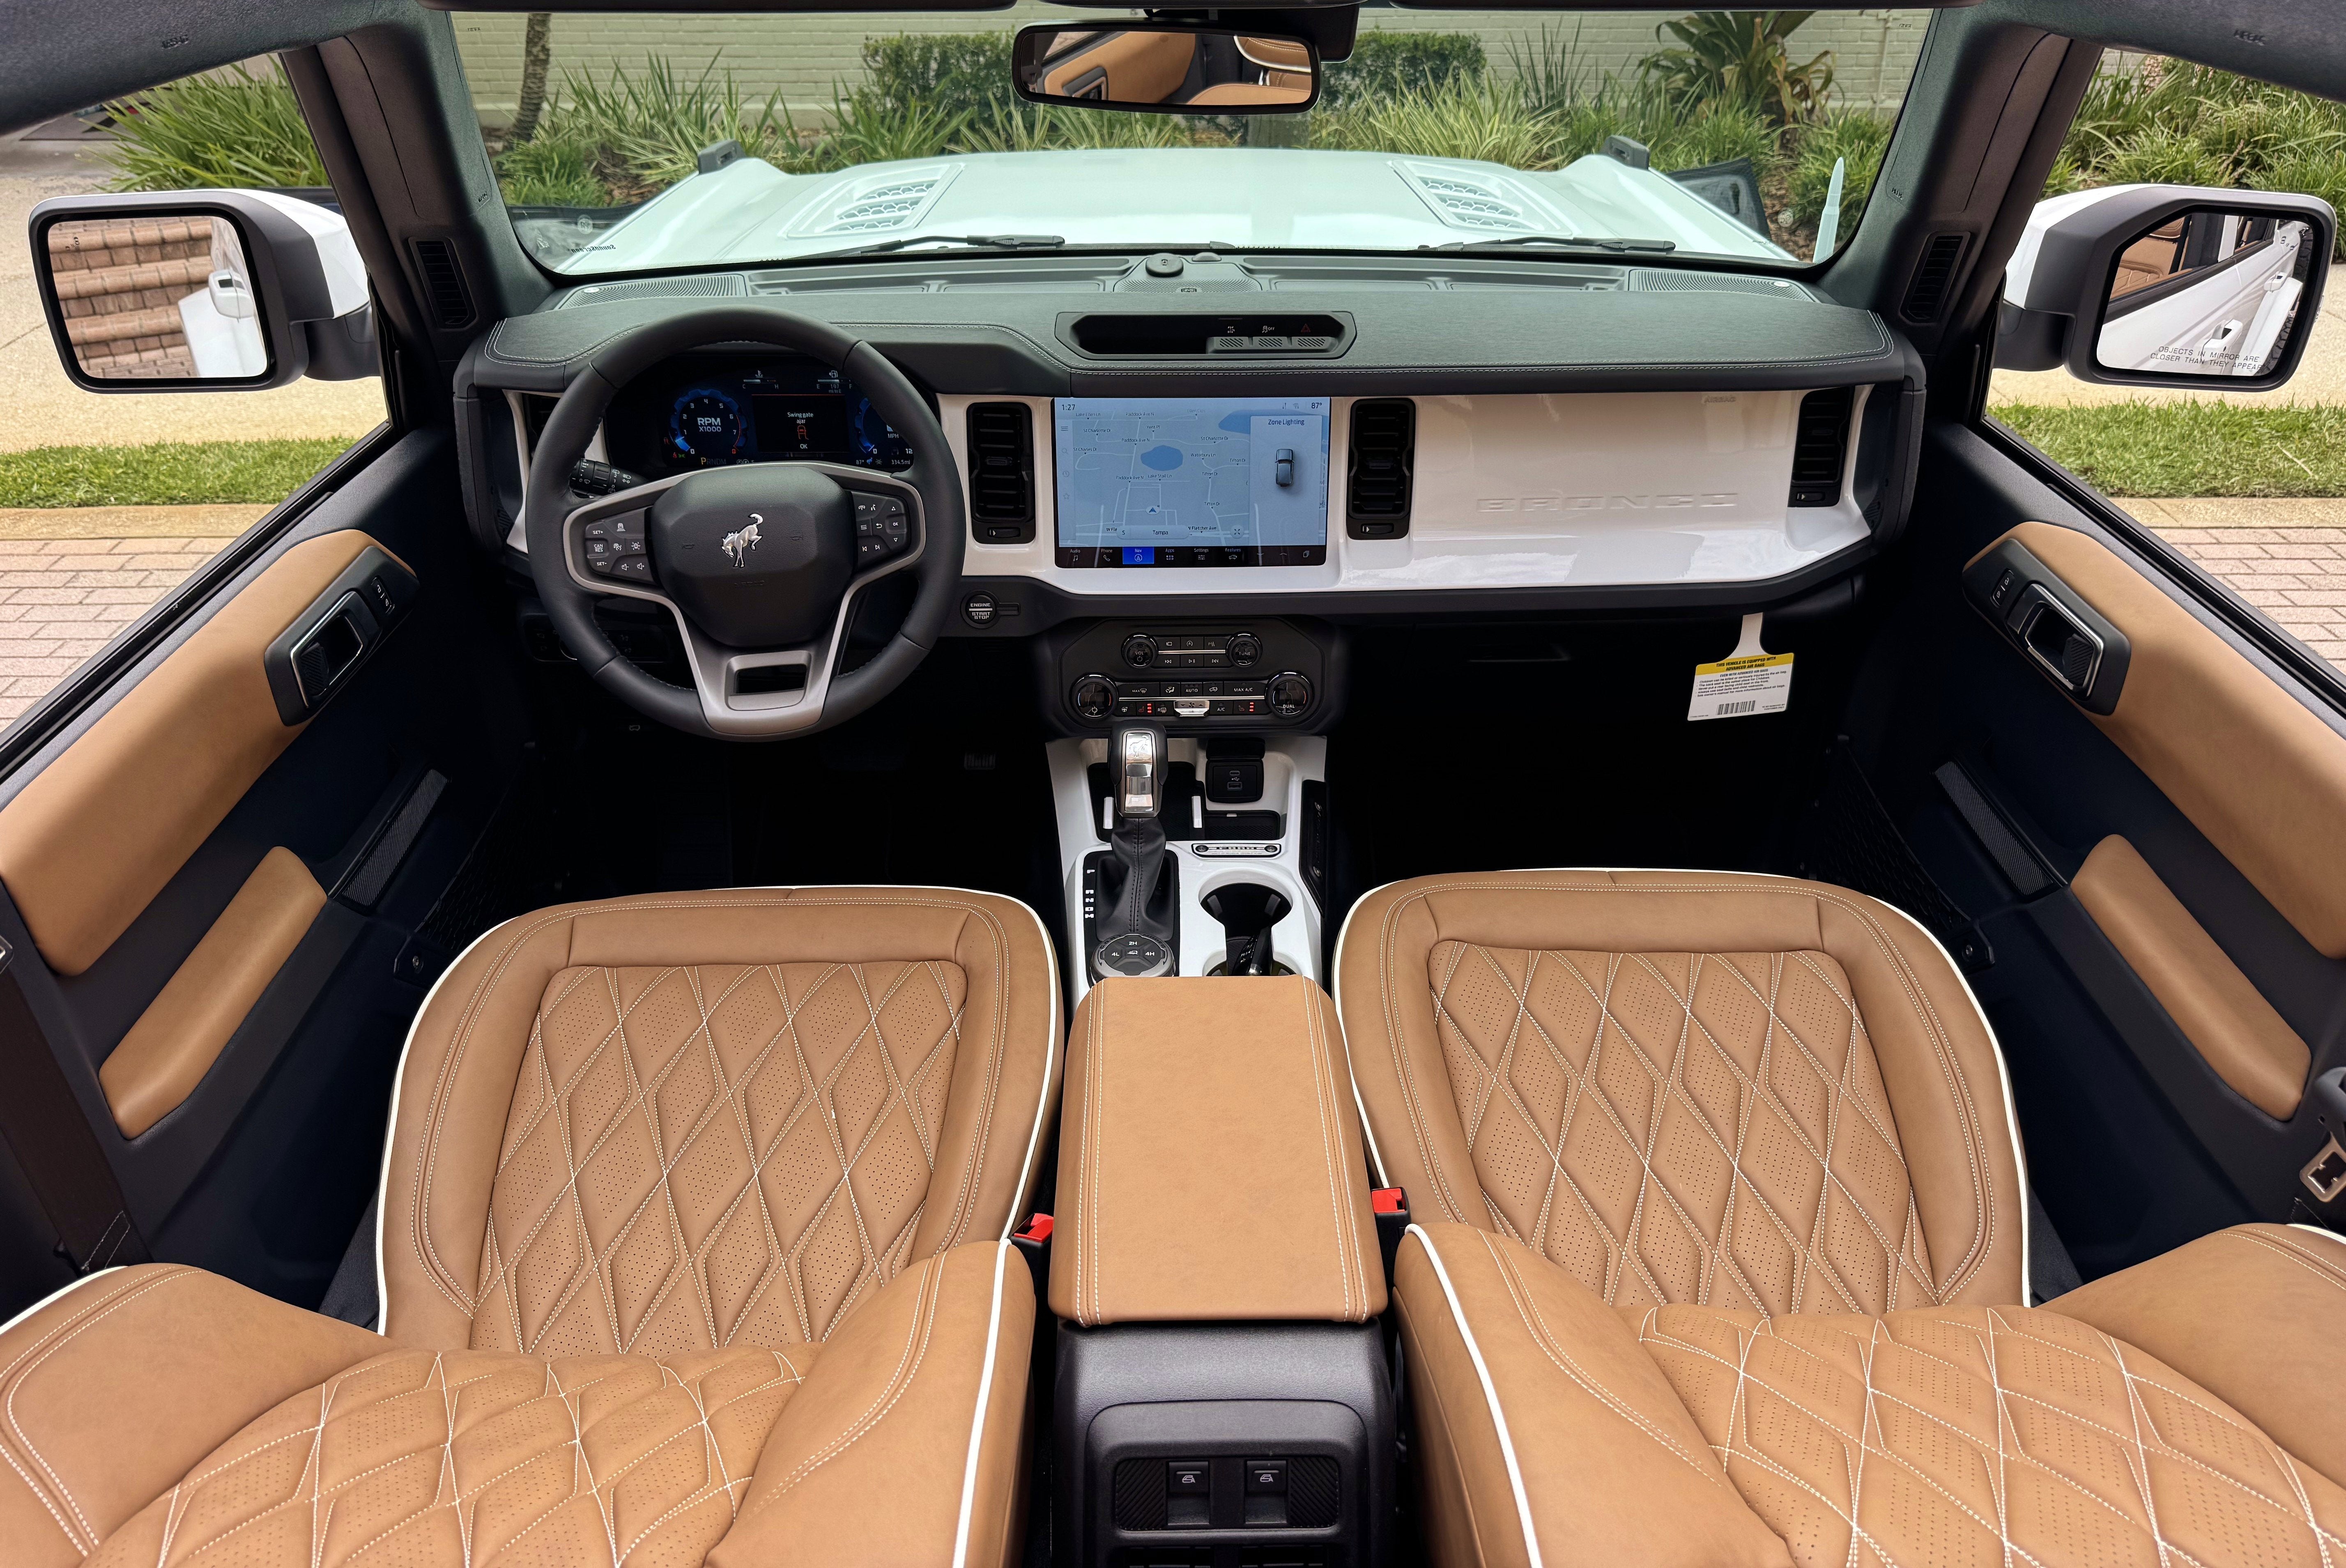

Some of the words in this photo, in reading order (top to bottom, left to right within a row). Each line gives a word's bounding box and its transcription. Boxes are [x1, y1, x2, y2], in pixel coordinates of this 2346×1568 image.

[2150, 353, 2180, 361] CLOSER
[2158, 346, 2193, 356] OBJECTS
[2210, 352, 2240, 360] MIRROR
[697, 417, 721, 425] RPM
